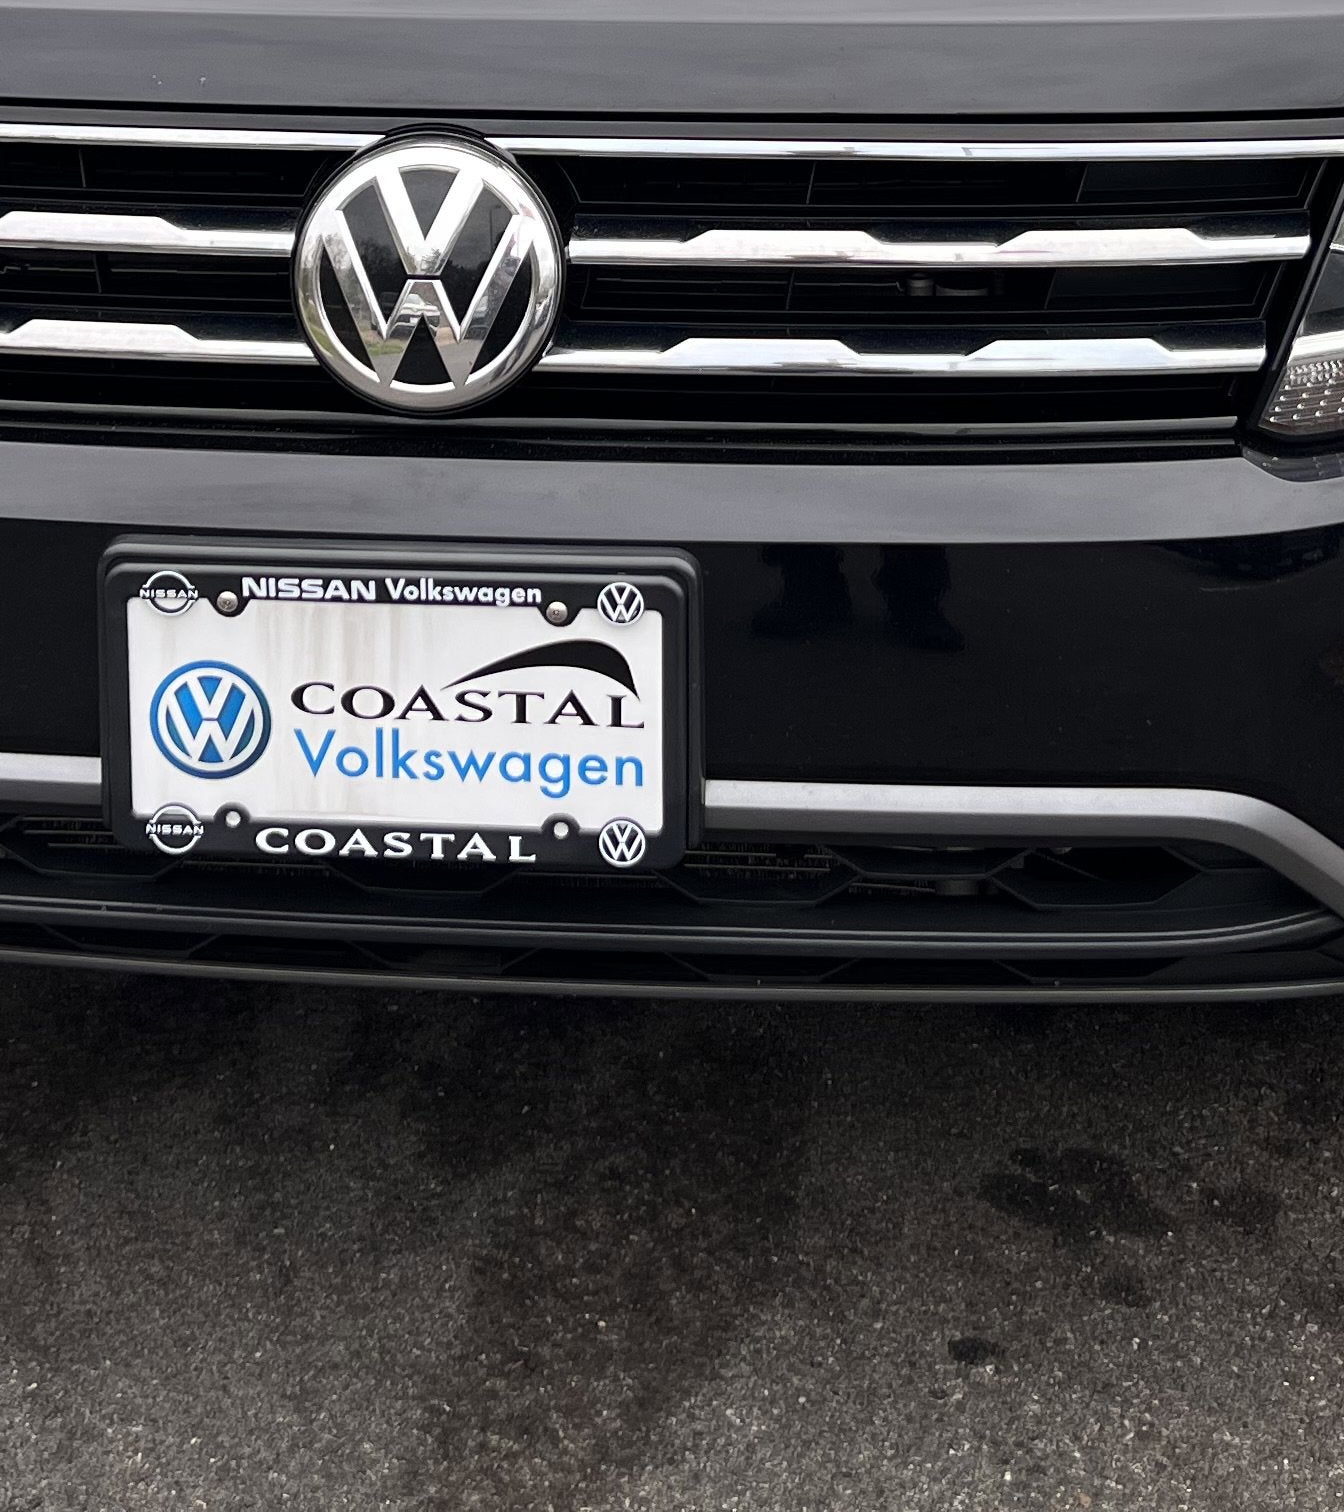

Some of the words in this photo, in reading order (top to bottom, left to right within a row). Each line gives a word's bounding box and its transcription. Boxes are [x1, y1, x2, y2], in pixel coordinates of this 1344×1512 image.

[296, 138, 560, 409] VW
[139, 589, 199, 599] NISSAN
[241, 577, 376, 601] NISSAN
[385, 578, 542, 607] Volkswagen
[150, 660, 272, 780] VW
[290, 681, 645, 730] COASTAL
[294, 727, 644, 799] Volkswagen
[145, 823, 204, 836] NISSAN
[256, 827, 537, 863] COASTAL
